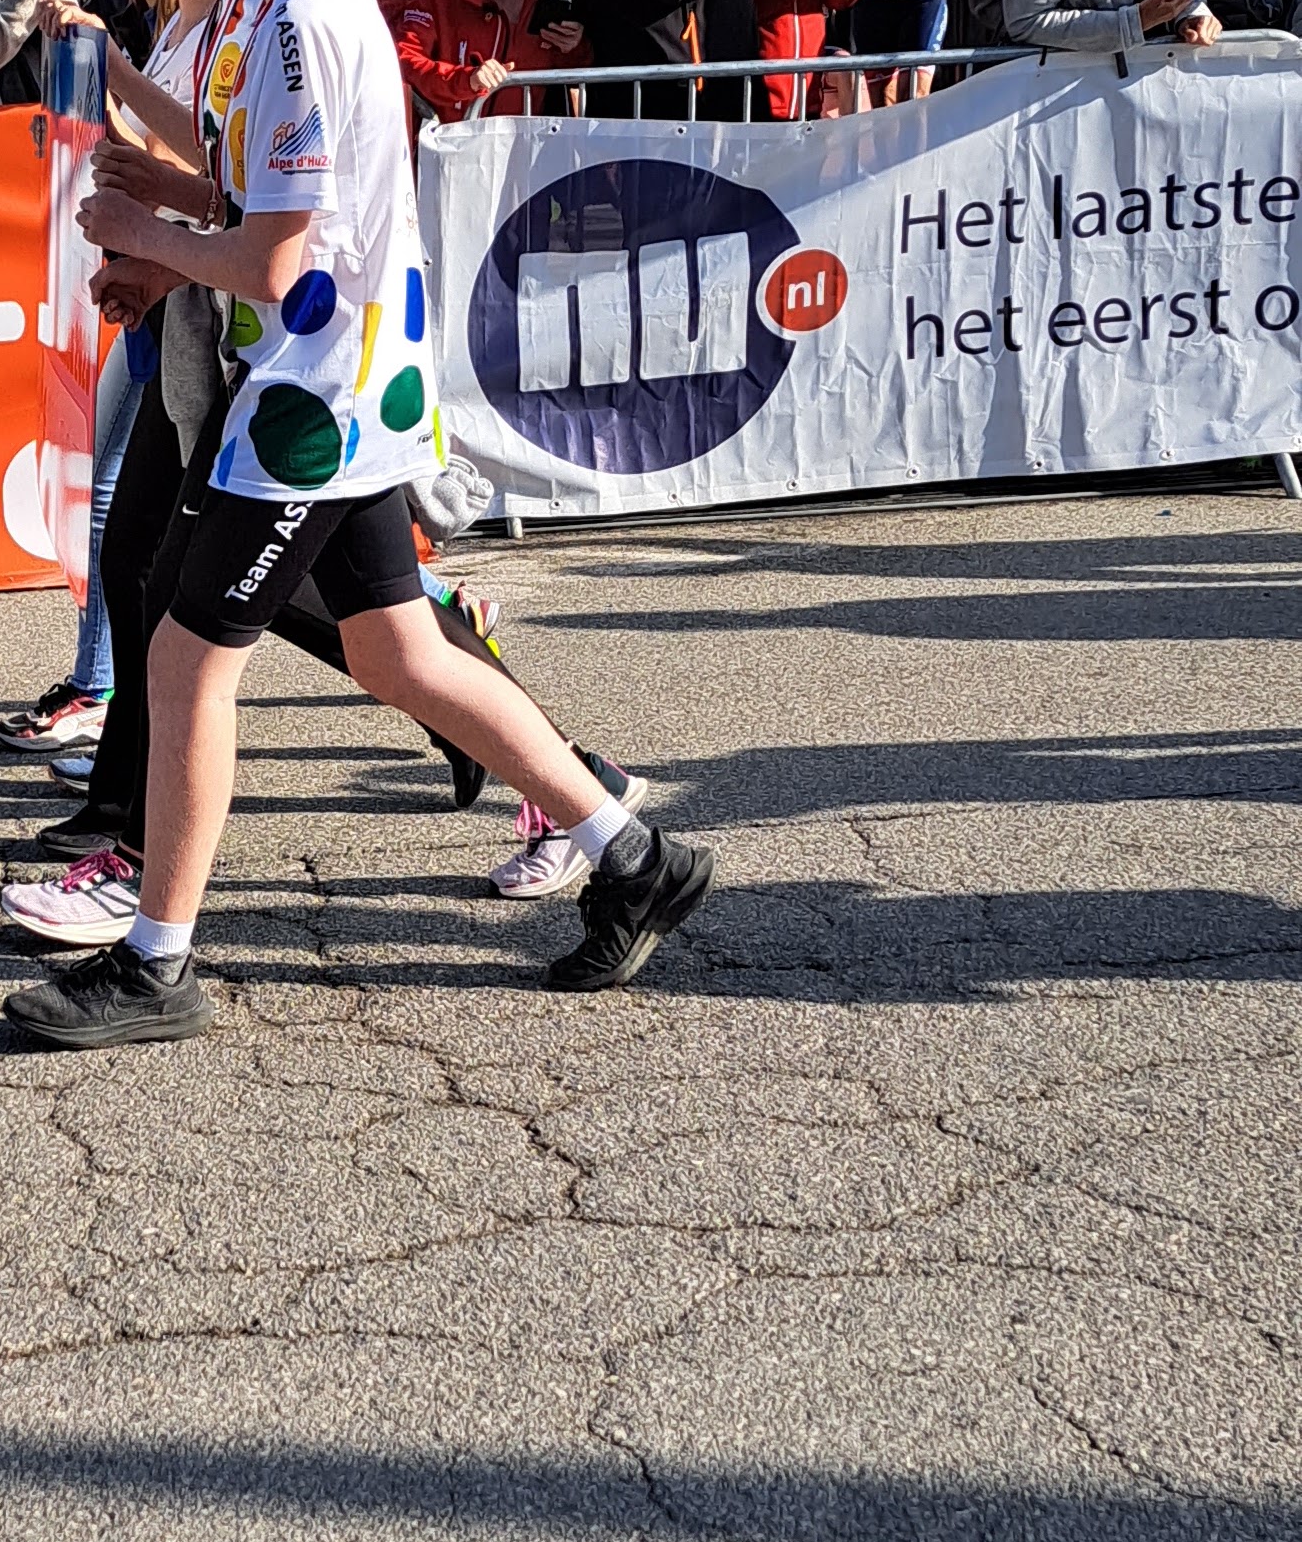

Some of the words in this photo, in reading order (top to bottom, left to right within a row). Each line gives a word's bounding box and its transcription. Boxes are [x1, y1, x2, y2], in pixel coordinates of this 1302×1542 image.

[275, 20, 305, 93] ASSEN
[267, 157, 294, 172] Alpe
[900, 186, 1026, 254] Het
[1052, 167, 1300, 240] laatste
[905, 294, 1024, 360] het
[1047, 278, 1231, 348] eerst
[224, 543, 285, 602] Team
[274, 501, 315, 541] AS
